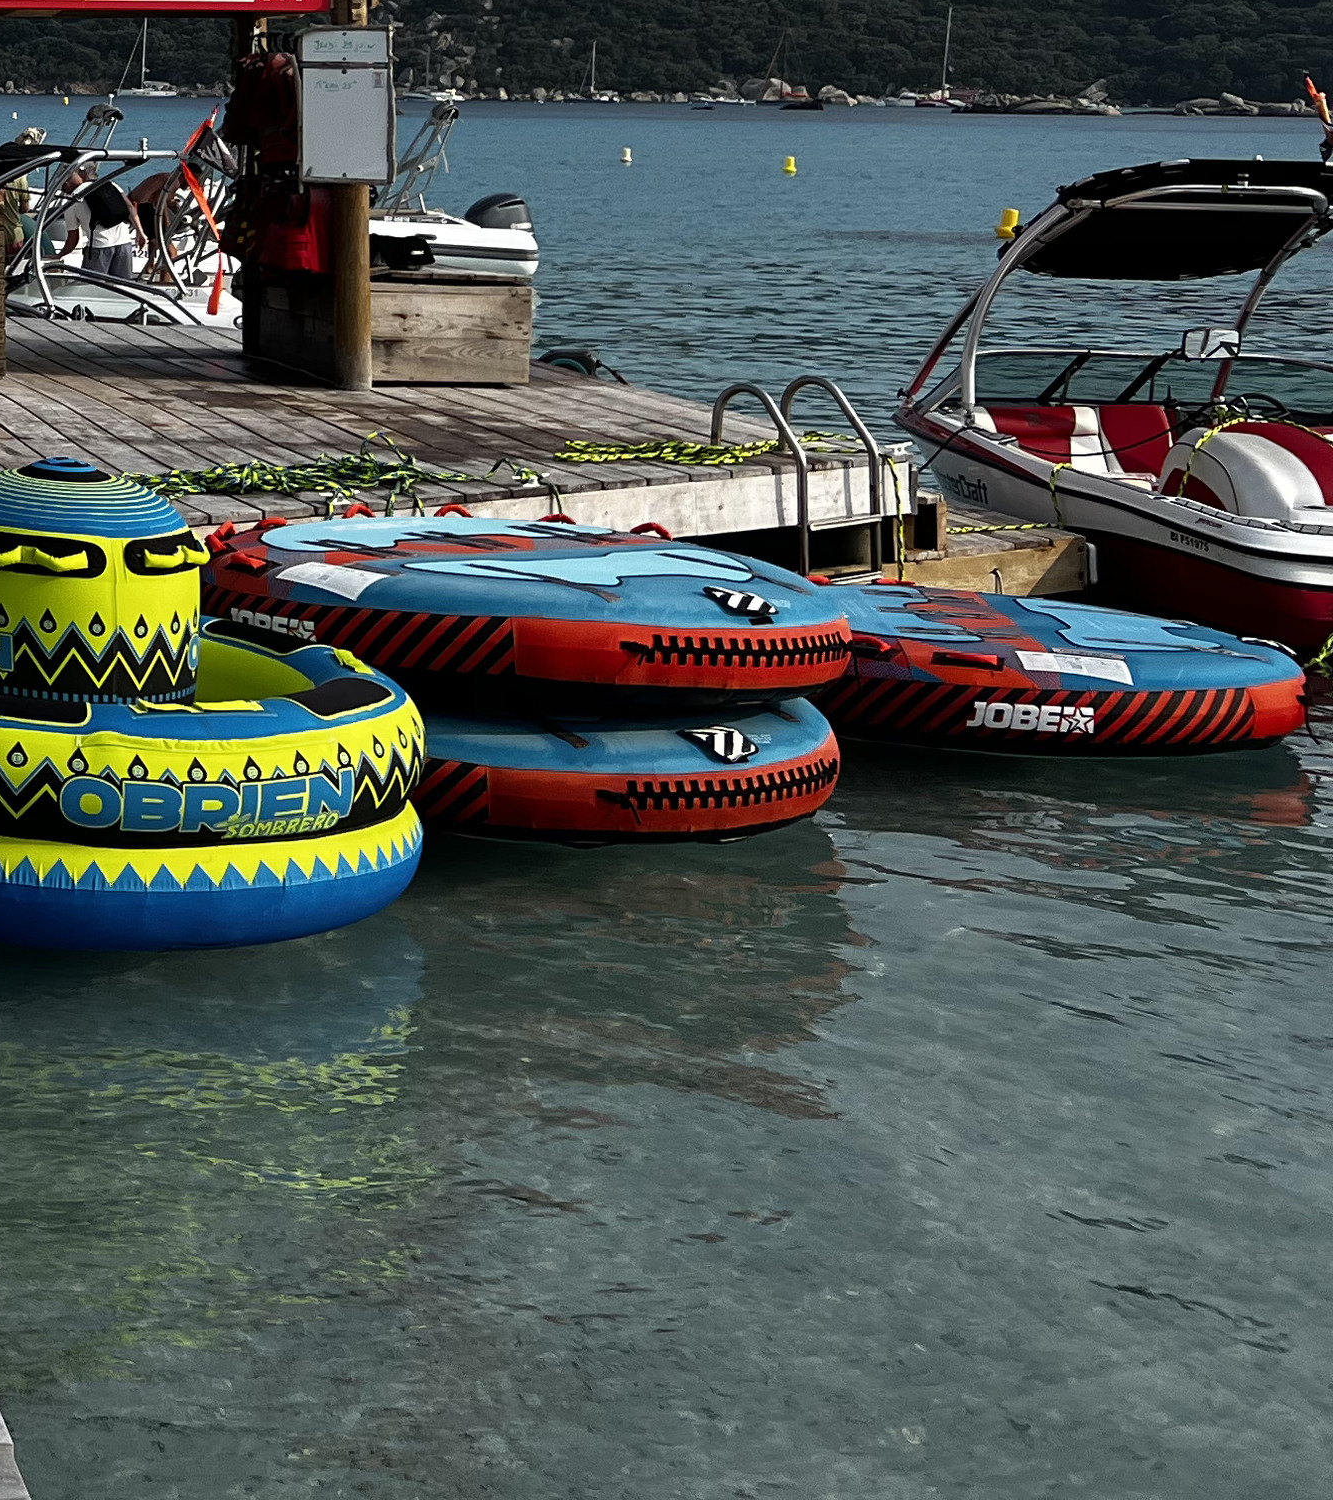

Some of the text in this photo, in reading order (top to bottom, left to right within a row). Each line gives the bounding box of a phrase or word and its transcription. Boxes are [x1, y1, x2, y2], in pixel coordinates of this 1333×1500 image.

[966, 701, 1063, 733] JOBE
[60, 766, 355, 832] OBRIEN
[223, 812, 339, 839] SOMBRERO
